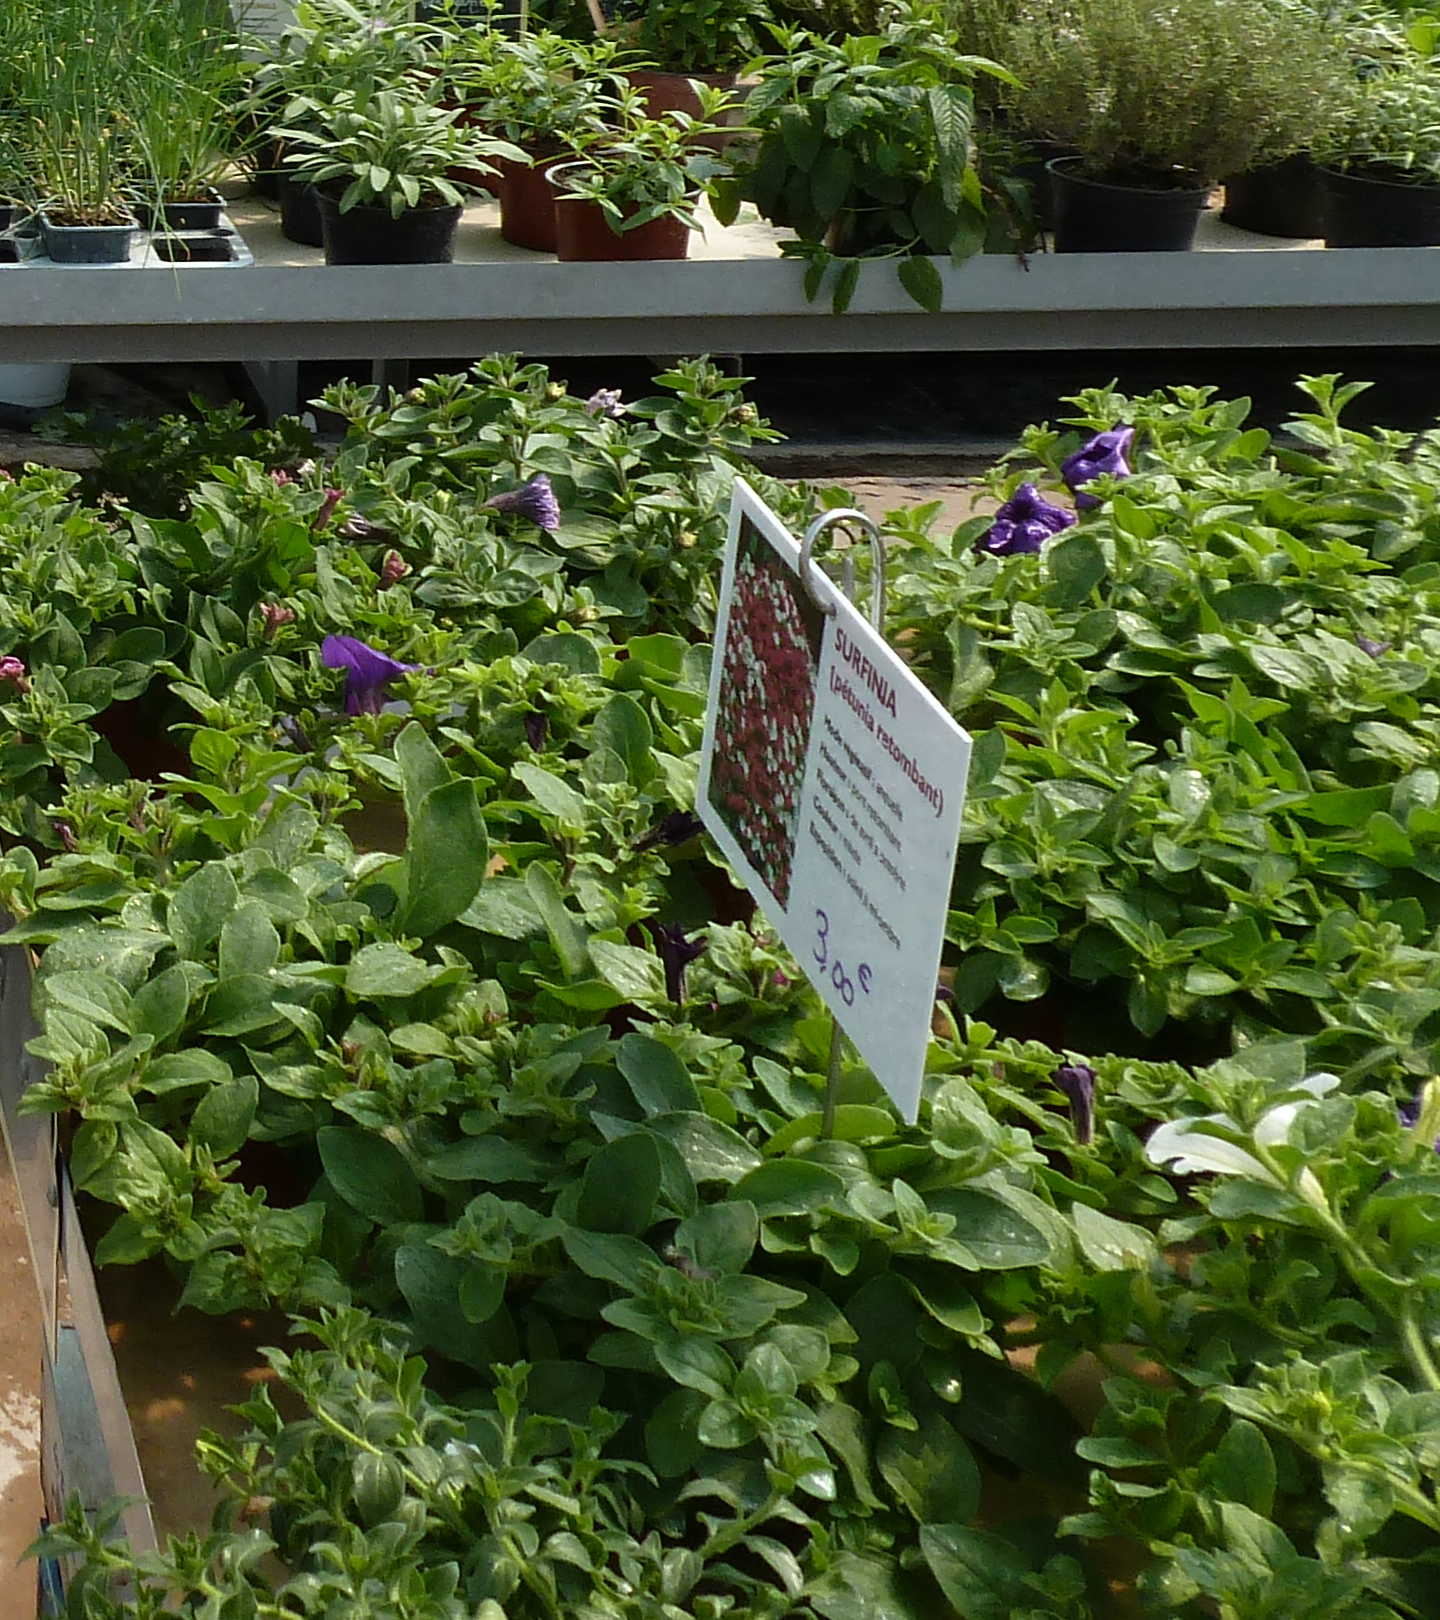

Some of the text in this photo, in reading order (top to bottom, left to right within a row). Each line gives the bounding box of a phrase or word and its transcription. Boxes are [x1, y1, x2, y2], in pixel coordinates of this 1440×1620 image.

[833, 627, 898, 718] SURFINIA
[828, 664, 945, 820] (pétunia retombant)
[812, 908, 873, 1007] 3,00€
